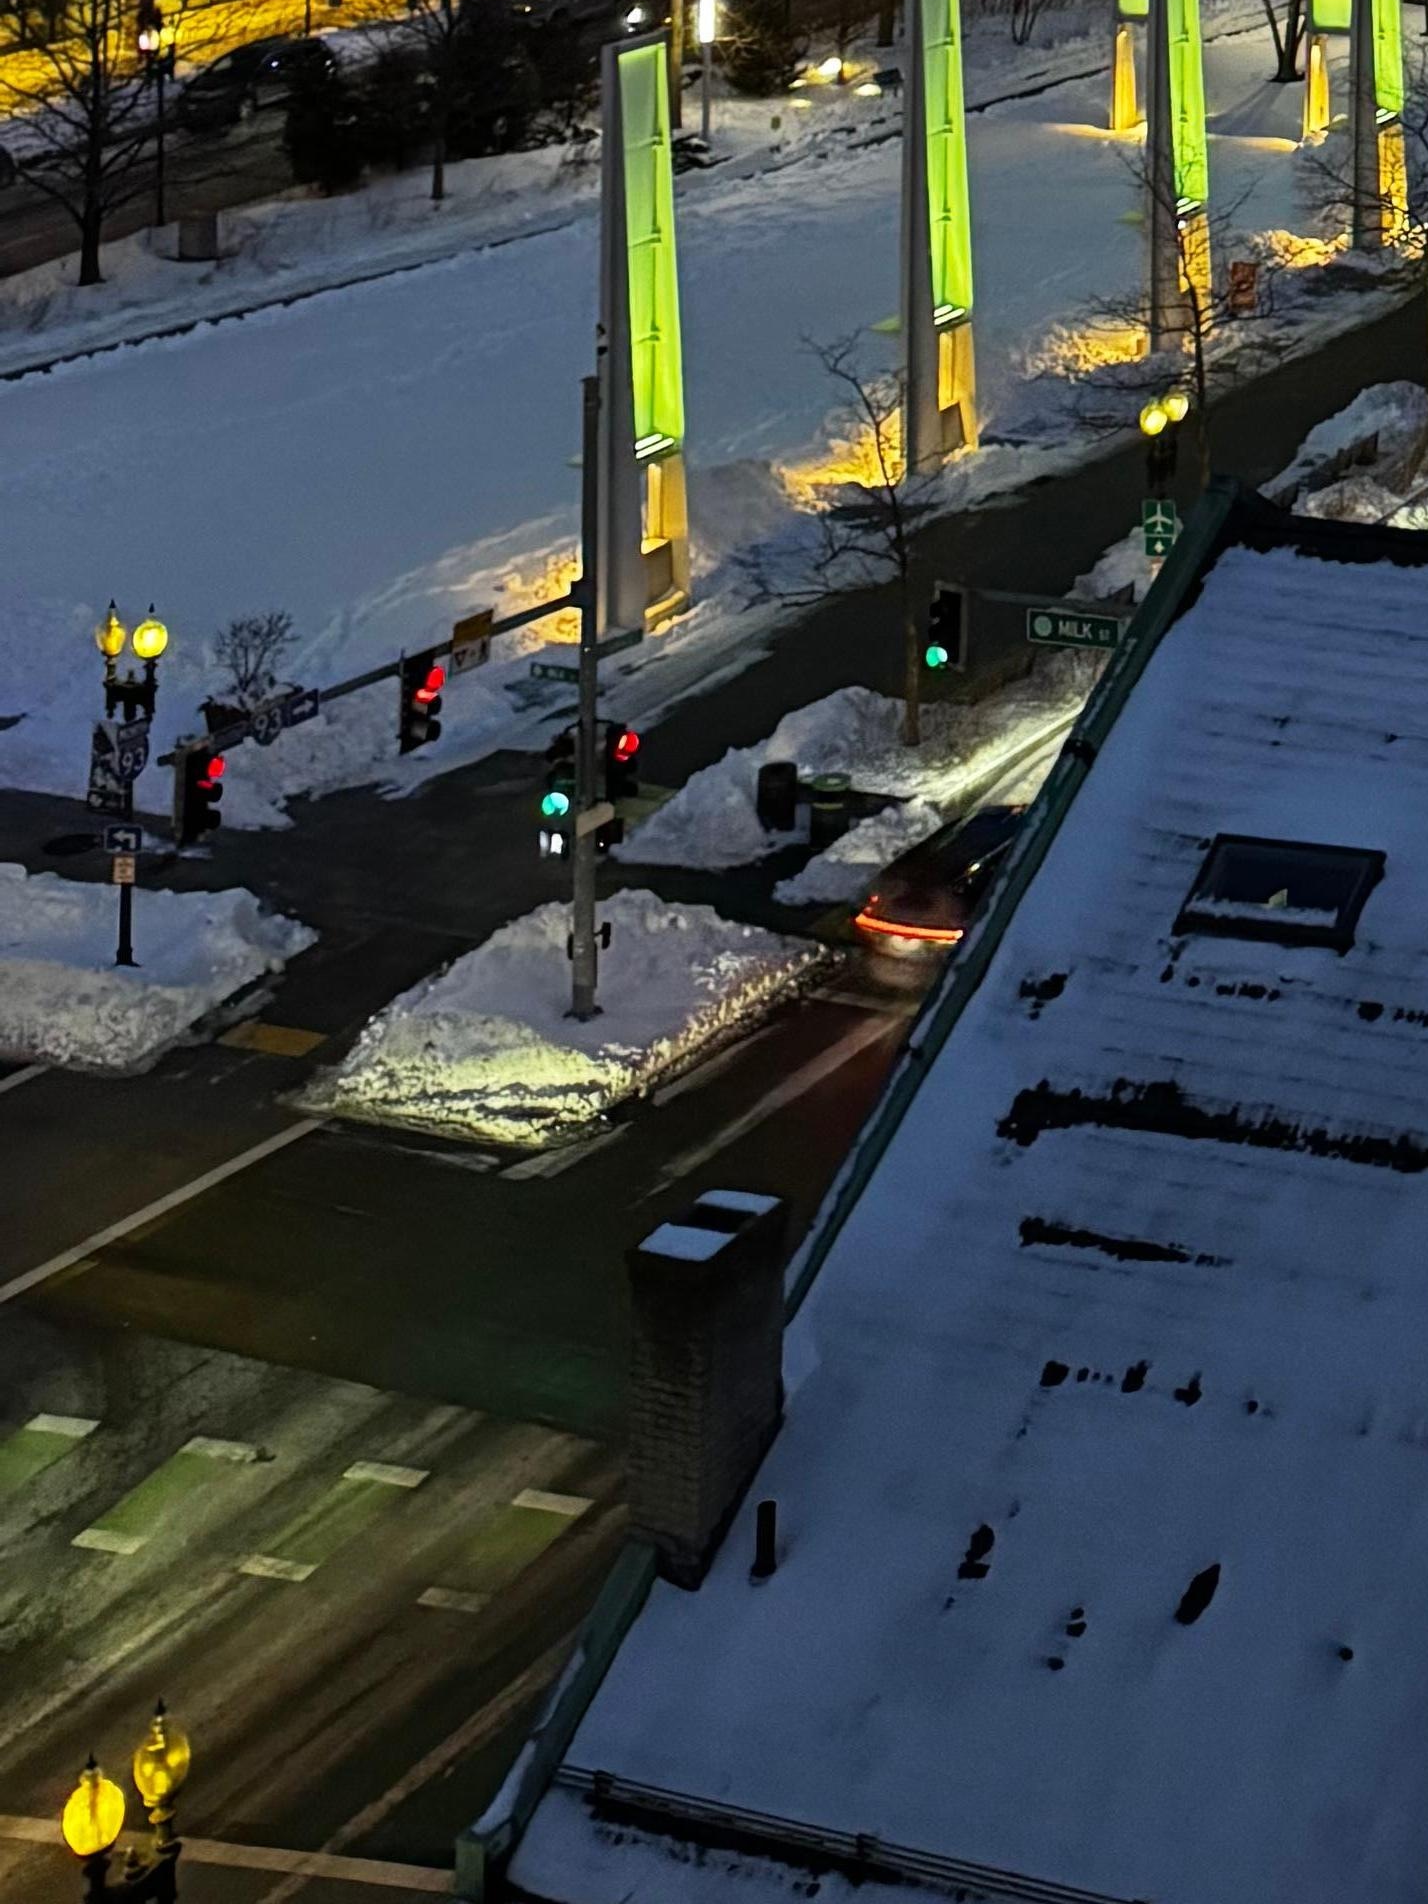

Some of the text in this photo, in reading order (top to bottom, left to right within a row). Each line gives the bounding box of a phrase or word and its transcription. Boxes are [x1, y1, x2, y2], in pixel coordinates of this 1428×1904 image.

[1058, 619, 1093, 640] MILK
[254, 707, 282, 740] 93
[121, 746, 146, 776] 93
